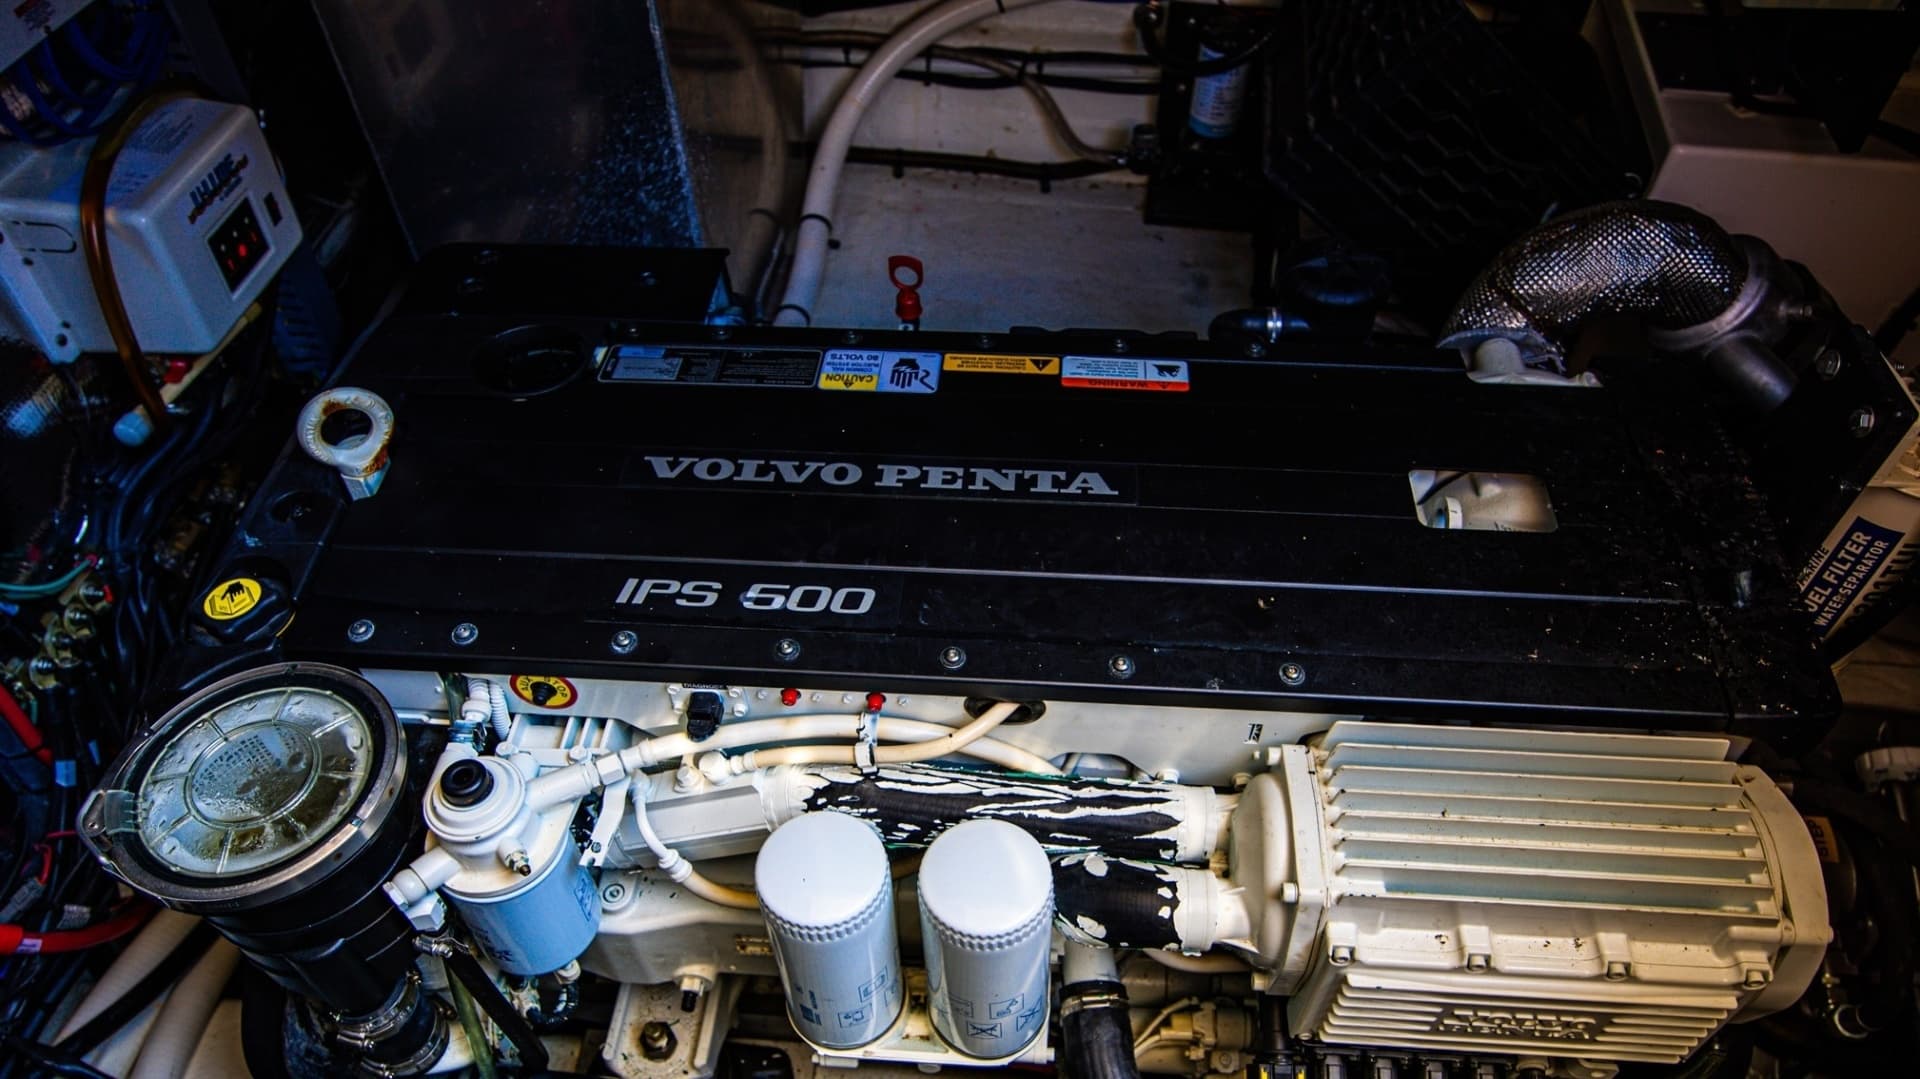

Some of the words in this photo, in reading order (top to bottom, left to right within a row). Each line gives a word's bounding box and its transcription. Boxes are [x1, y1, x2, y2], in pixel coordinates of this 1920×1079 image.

[830, 353, 864, 361] VOLTS
[825, 374, 874, 383] CAUTION
[1087, 378, 1149, 388] WARNING
[644, 456, 863, 486] VOLVO
[875, 464, 1119, 496] PENTA
[1822, 531, 1872, 585] FILTER
[615, 577, 722, 608] IPS
[742, 584, 876, 615] 500
[1813, 594, 1844, 627] WATER
[1840, 540, 1889, 596] SEPARATOR
